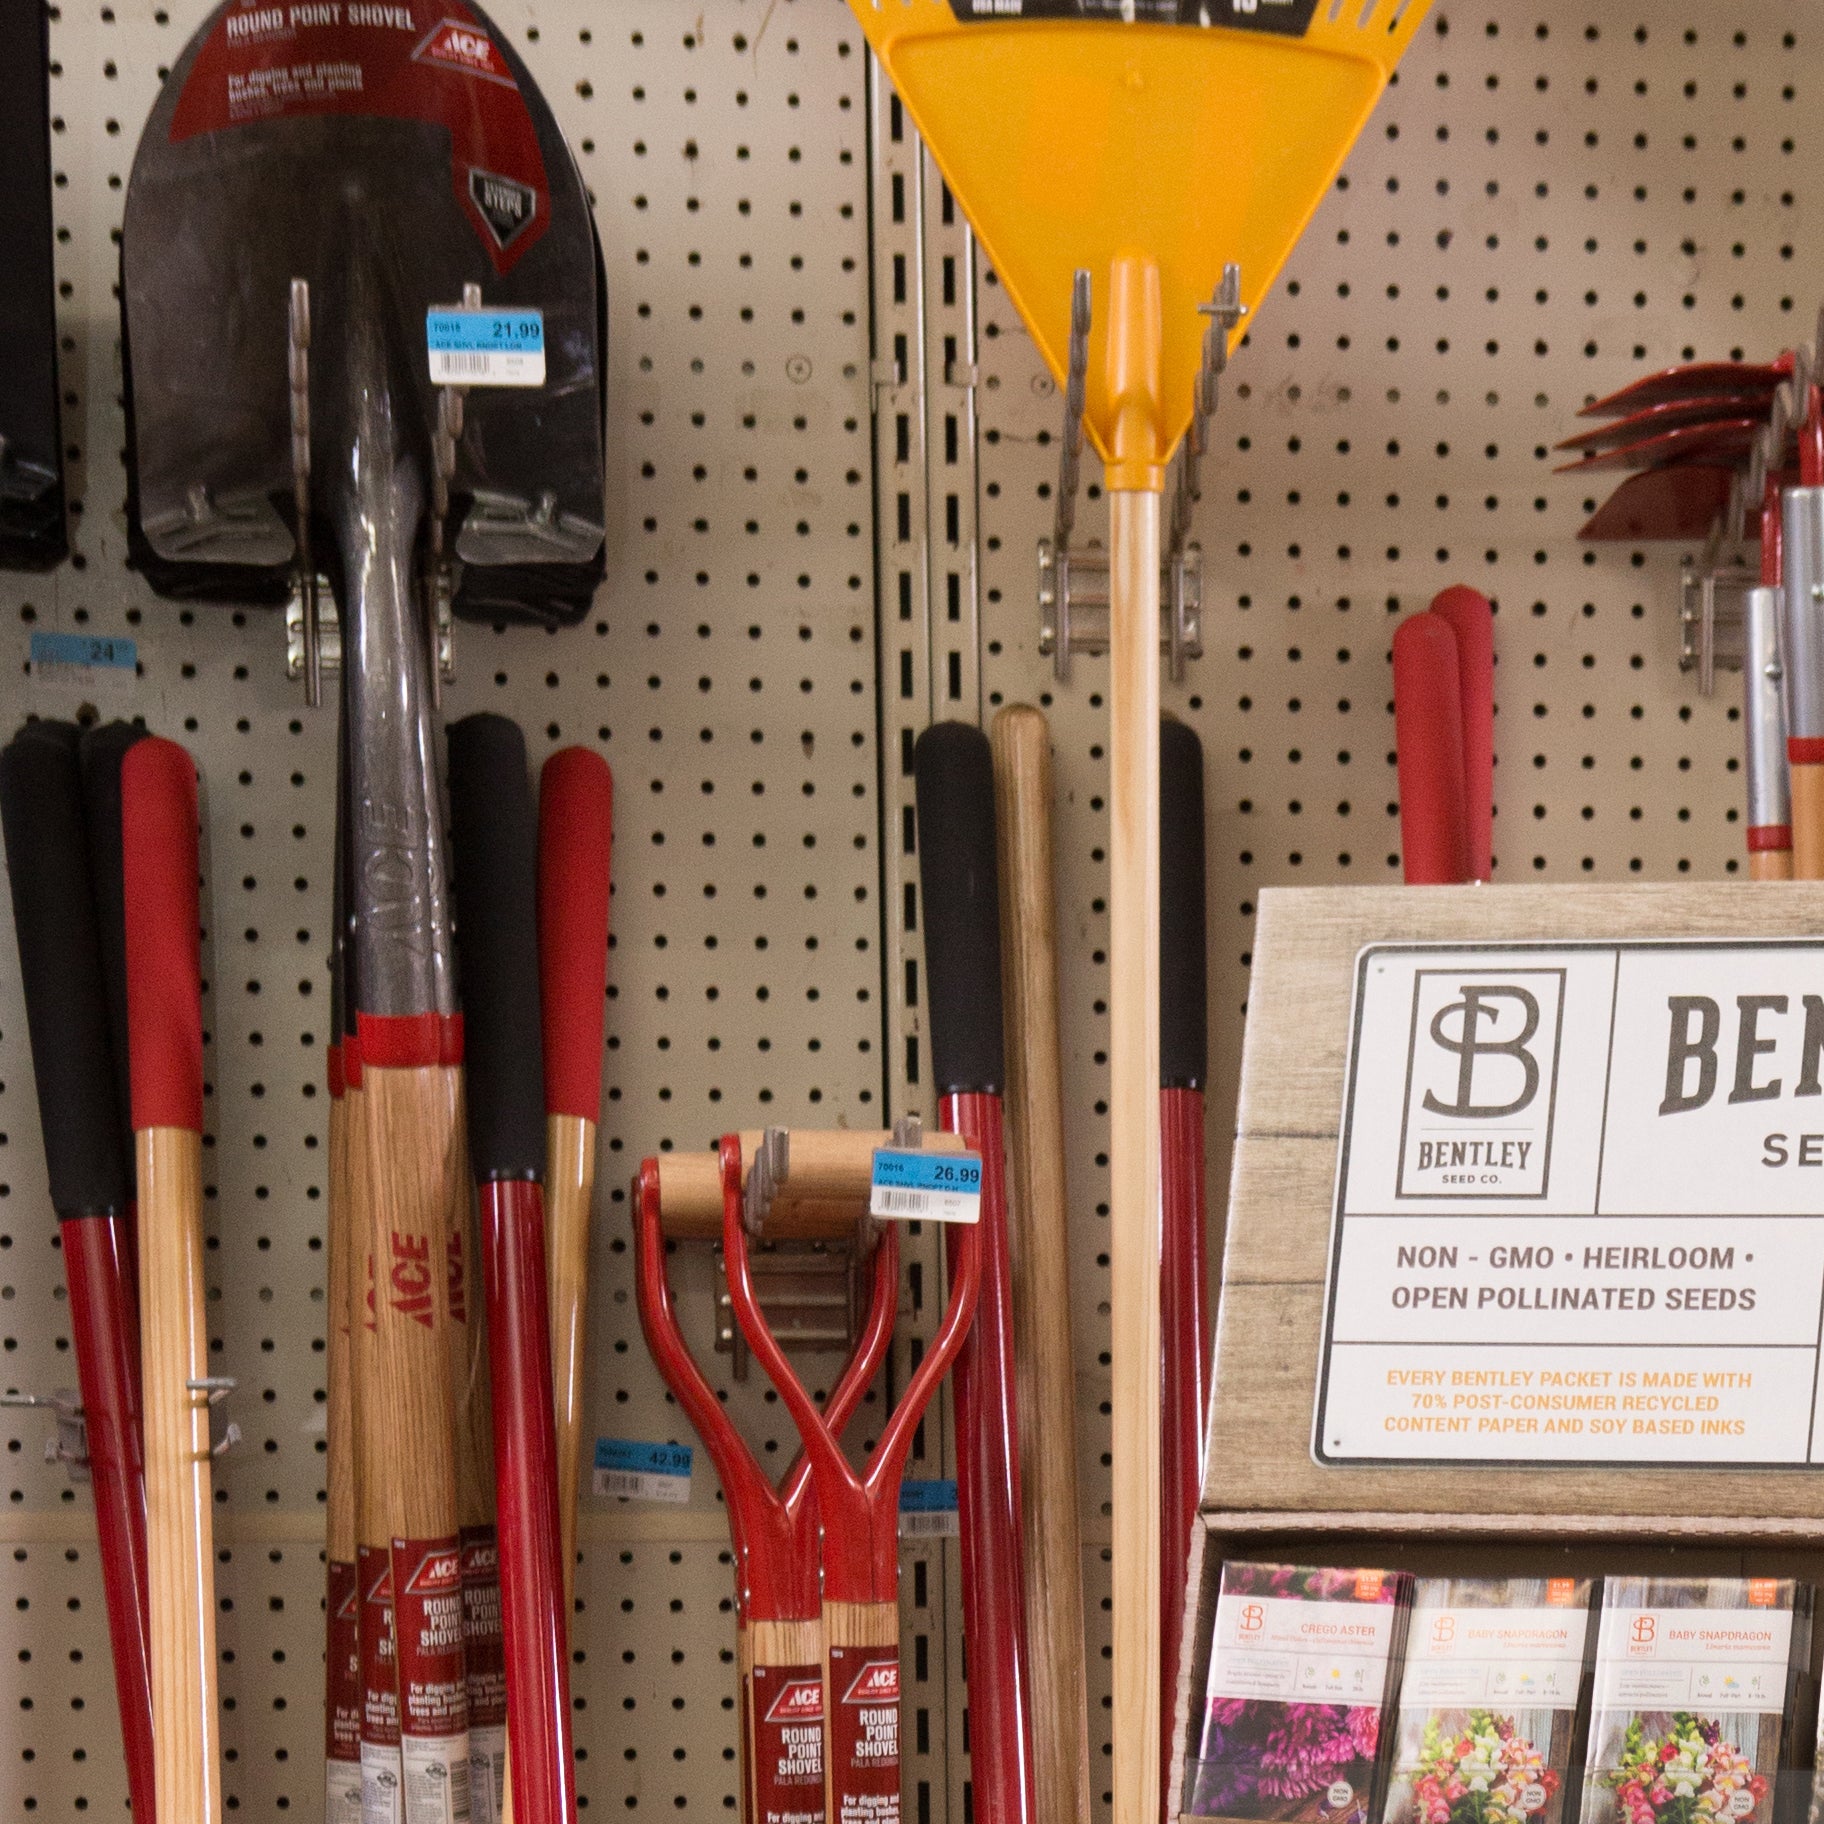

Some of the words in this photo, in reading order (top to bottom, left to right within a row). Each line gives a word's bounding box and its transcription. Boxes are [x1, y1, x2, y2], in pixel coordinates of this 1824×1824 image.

[227, 7, 283, 39] ROUND
[290, 2, 341, 28] POINT
[348, 3, 416, 32] SHOVEL
[1417, 1140, 1533, 1172] BENTLEY
[934, 1165, 979, 1183] 26.99
[1442, 1174, 1476, 1185] SEED
[1480, 1174, 1503, 1185] CO.
[1397, 1246, 1458, 1269] NON
[1489, 1246, 1554, 1269] GMO
[1583, 1247, 1734, 1270] HEIRLOOM
[390, 1230, 433, 1330] ACE
[1392, 1286, 1468, 1310] OPEN
[1477, 1287, 1655, 1311] POLLINATED
[1665, 1288, 1756, 1311] SEEDS
[1387, 1370, 1447, 1387] EVERY
[1451, 1370, 1533, 1387] BENTLEY
[1540, 1371, 1612, 1388] PACKET
[1619, 1372, 1636, 1388] IS
[1642, 1372, 1697, 1388] MADE
[1702, 1373, 1752, 1389] WITH
[1412, 1394, 1447, 1410] 70%
[1453, 1394, 1617, 1411] POST-CONSUMER
[1622, 1395, 1719, 1412] RECYCLED
[1384, 1416, 1472, 1433] CONTENT
[1478, 1417, 1539, 1434] PAPER
[1544, 1418, 1584, 1434] AND
[1589, 1418, 1627, 1435] SOY
[1633, 1419, 1695, 1435] BASED
[1700, 1419, 1745, 1435] INKS
[1301, 1623, 1337, 1635] CREGO
[1341, 1626, 1375, 1636] ASTER
[1669, 1630, 1695, 1640] BABY
[1699, 1631, 1772, 1640] SNAPDRAGON
[867, 1670, 897, 1686] ACE
[789, 1689, 820, 1705] ACE
[859, 1708, 898, 1726] ROUND
[781, 1726, 821, 1744] ROUND
[866, 1725, 898, 1742] POINT
[789, 1742, 822, 1759] POINT
[855, 1741, 898, 1757] SHOVEL
[778, 1759, 822, 1775] SHOVEL
